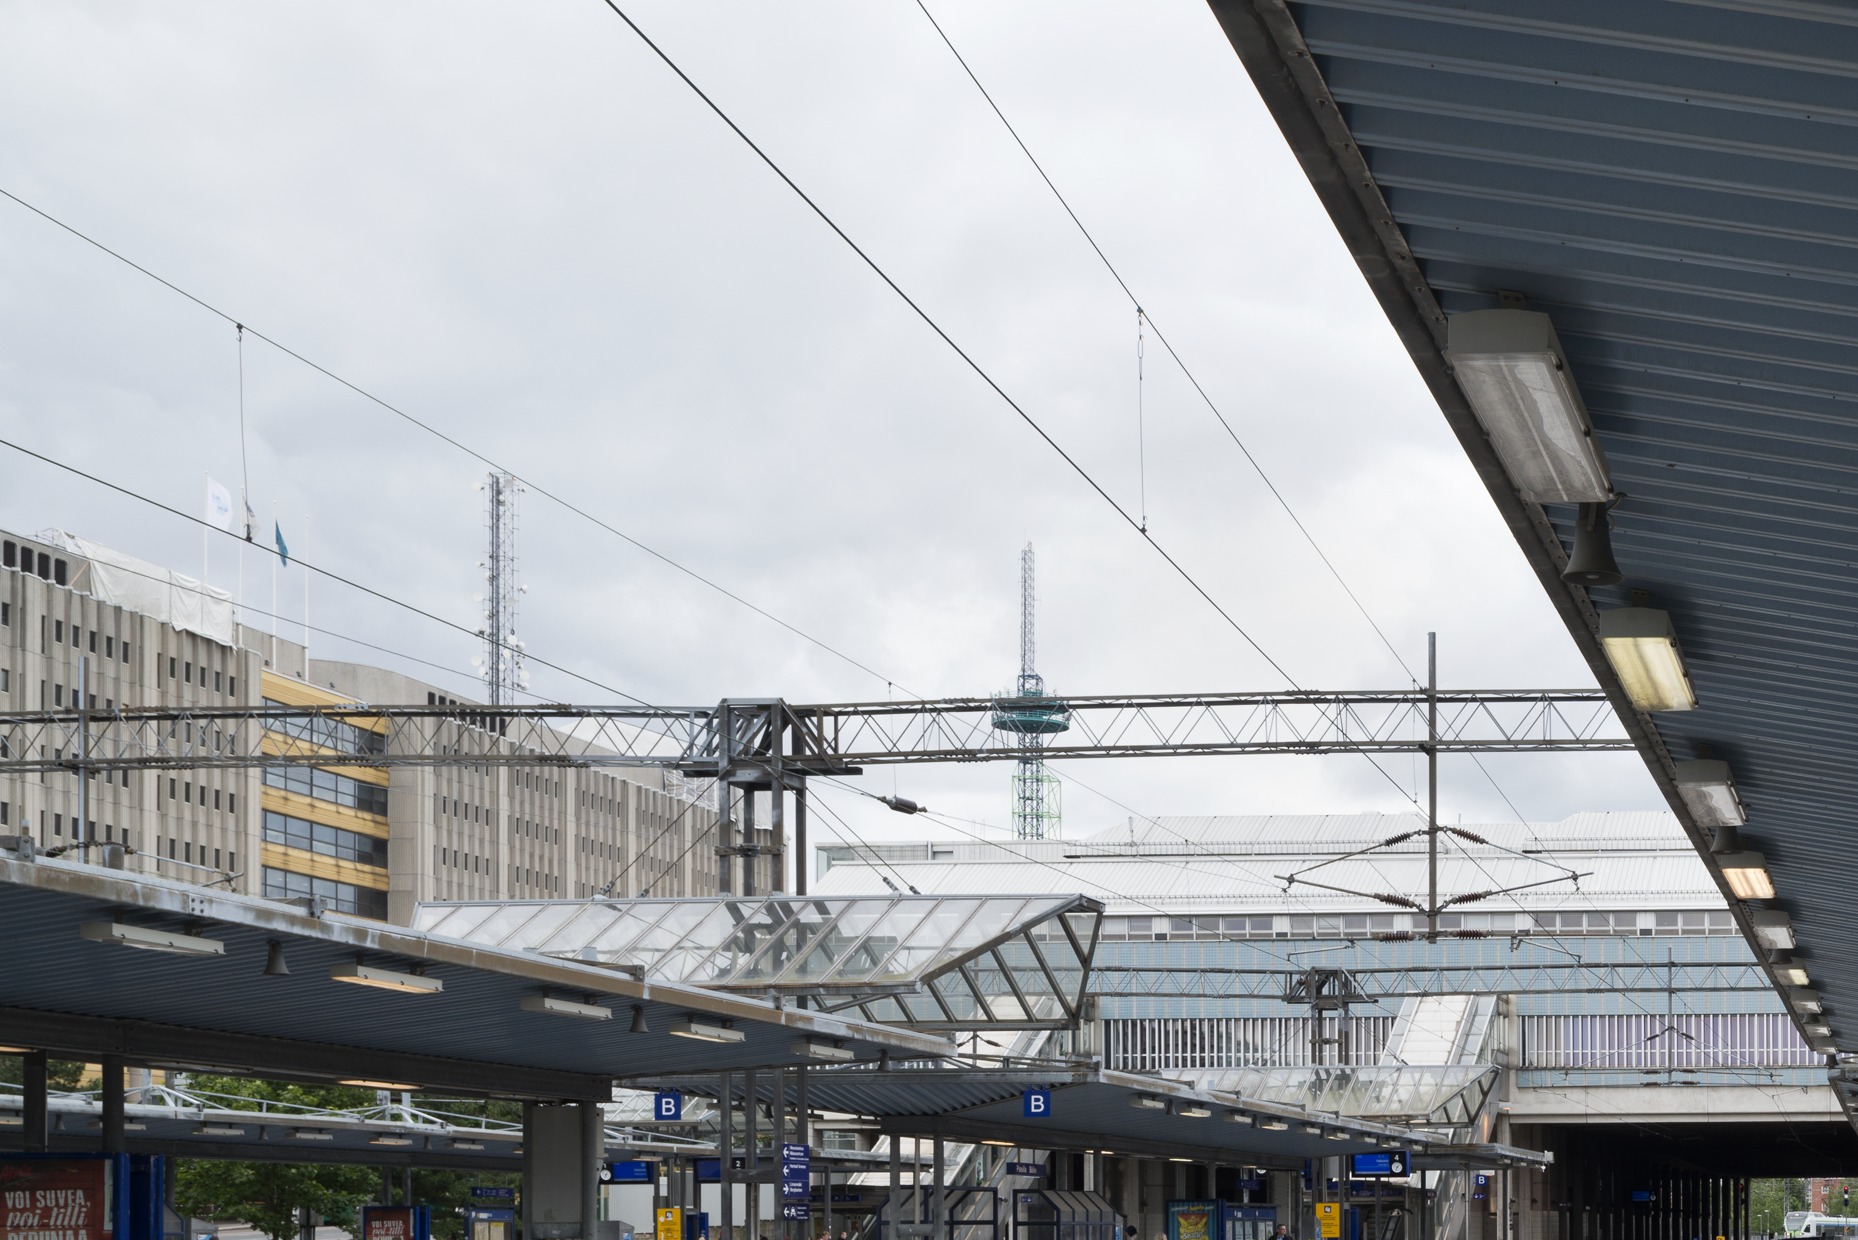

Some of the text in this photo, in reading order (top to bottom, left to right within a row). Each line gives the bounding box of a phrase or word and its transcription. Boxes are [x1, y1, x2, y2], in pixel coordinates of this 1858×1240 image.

[661, 1098, 676, 1116] B
[1030, 1095, 1045, 1113] B
[1478, 1176, 1485, 1184] B
[5, 1189, 91, 1209] VOI SUVEA,
